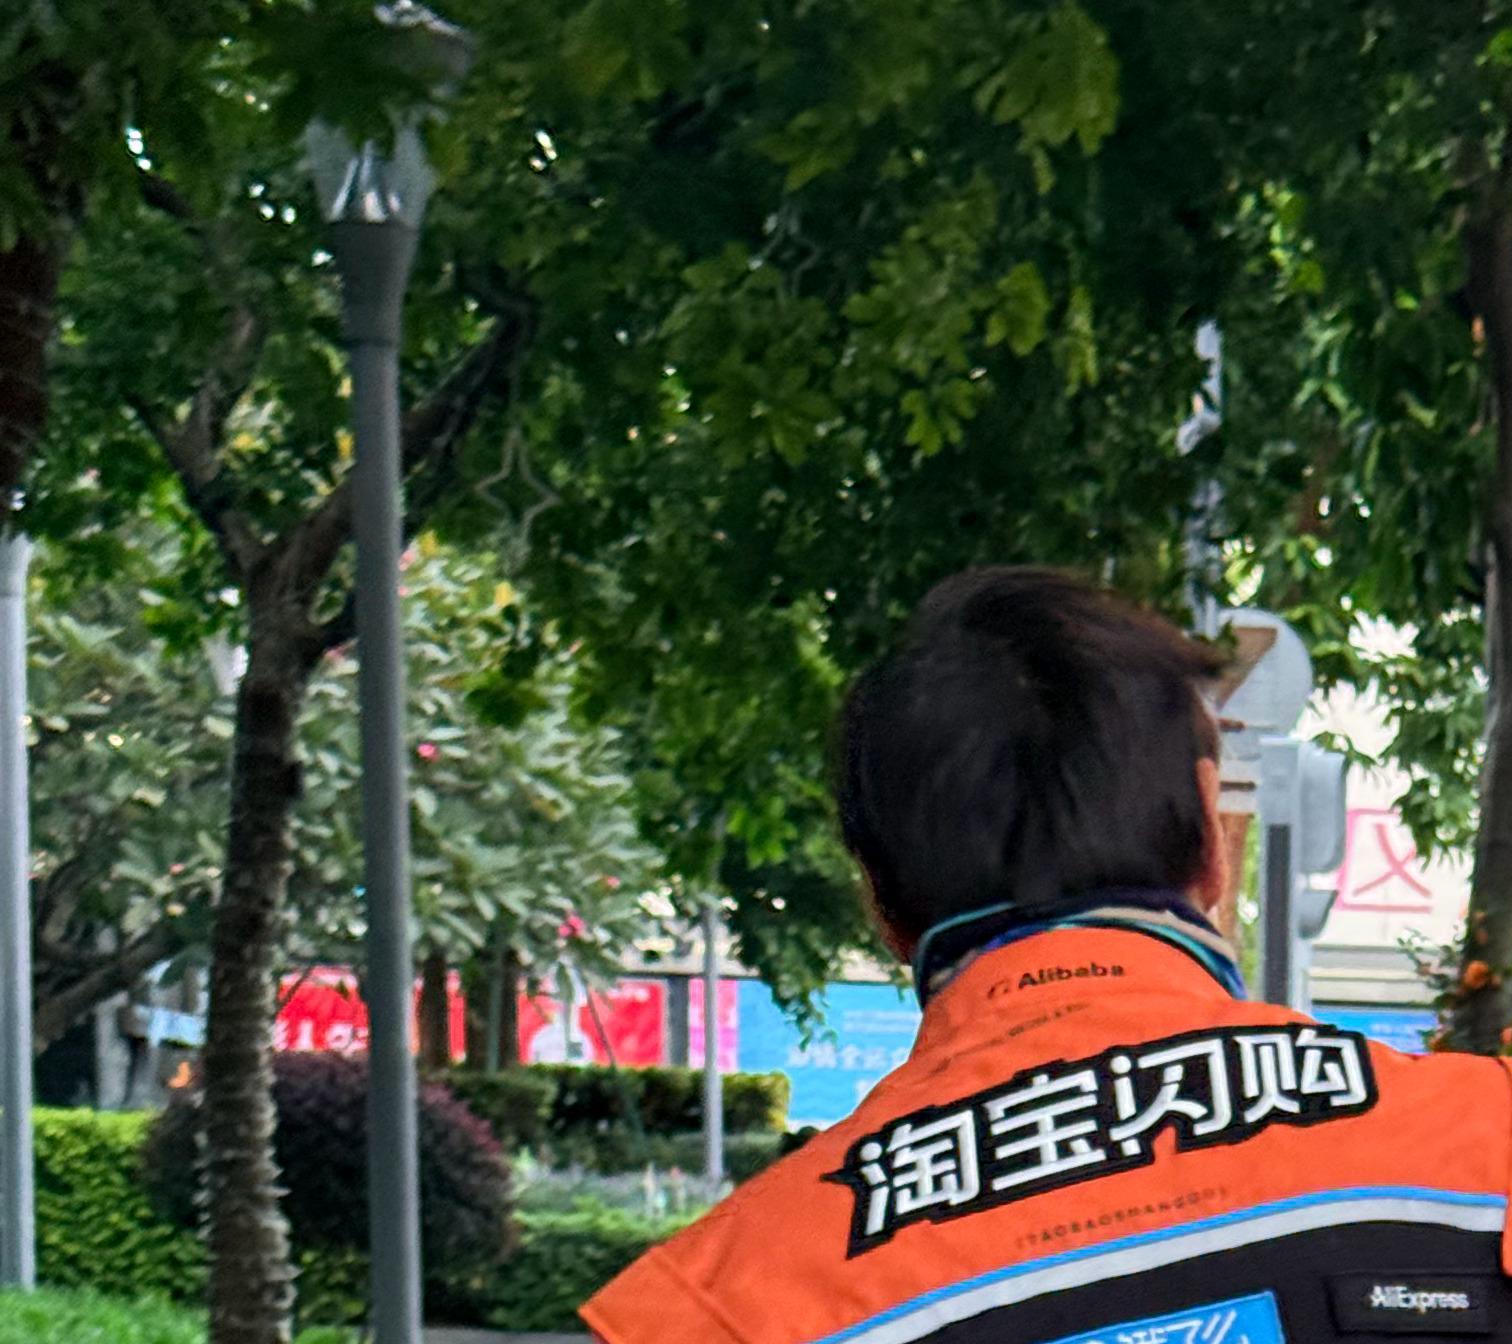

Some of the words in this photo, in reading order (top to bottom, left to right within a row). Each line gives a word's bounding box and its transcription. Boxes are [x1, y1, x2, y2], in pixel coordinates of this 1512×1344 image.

[1017, 960, 1125, 989] Alibaba
[857, 1031, 1369, 1237] 淘宝闪购
[1369, 1285, 1471, 1316] AliExpress
